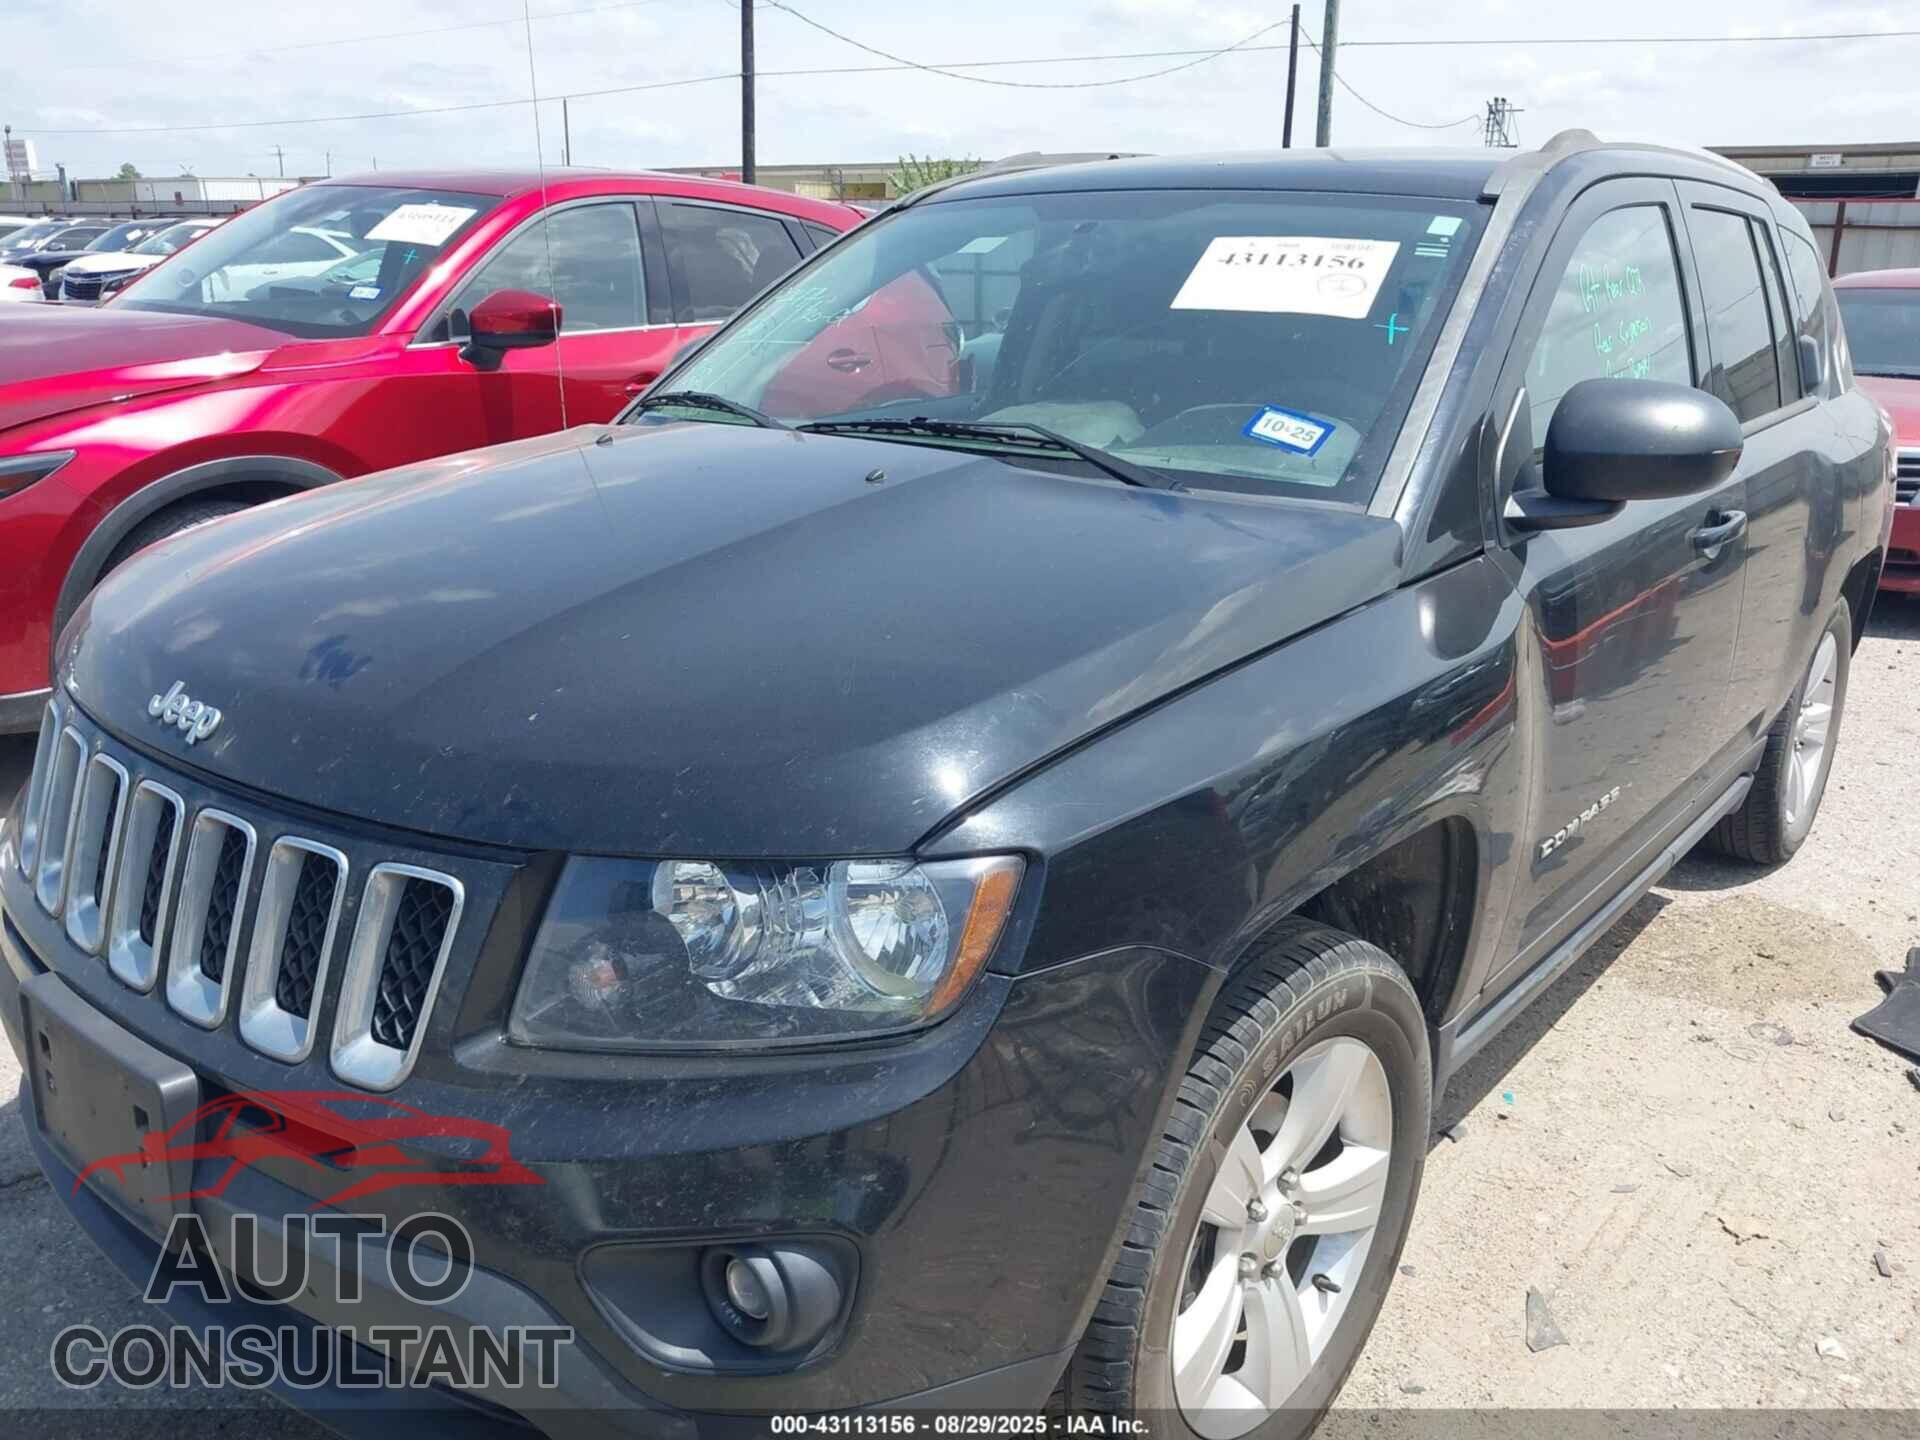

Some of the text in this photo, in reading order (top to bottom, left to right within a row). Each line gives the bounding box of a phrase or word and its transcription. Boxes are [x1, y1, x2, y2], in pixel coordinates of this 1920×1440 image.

[1217, 252, 1365, 270] 43113156
[148, 680, 221, 745] Jeep
[1262, 987, 1348, 1078] SAILUN
